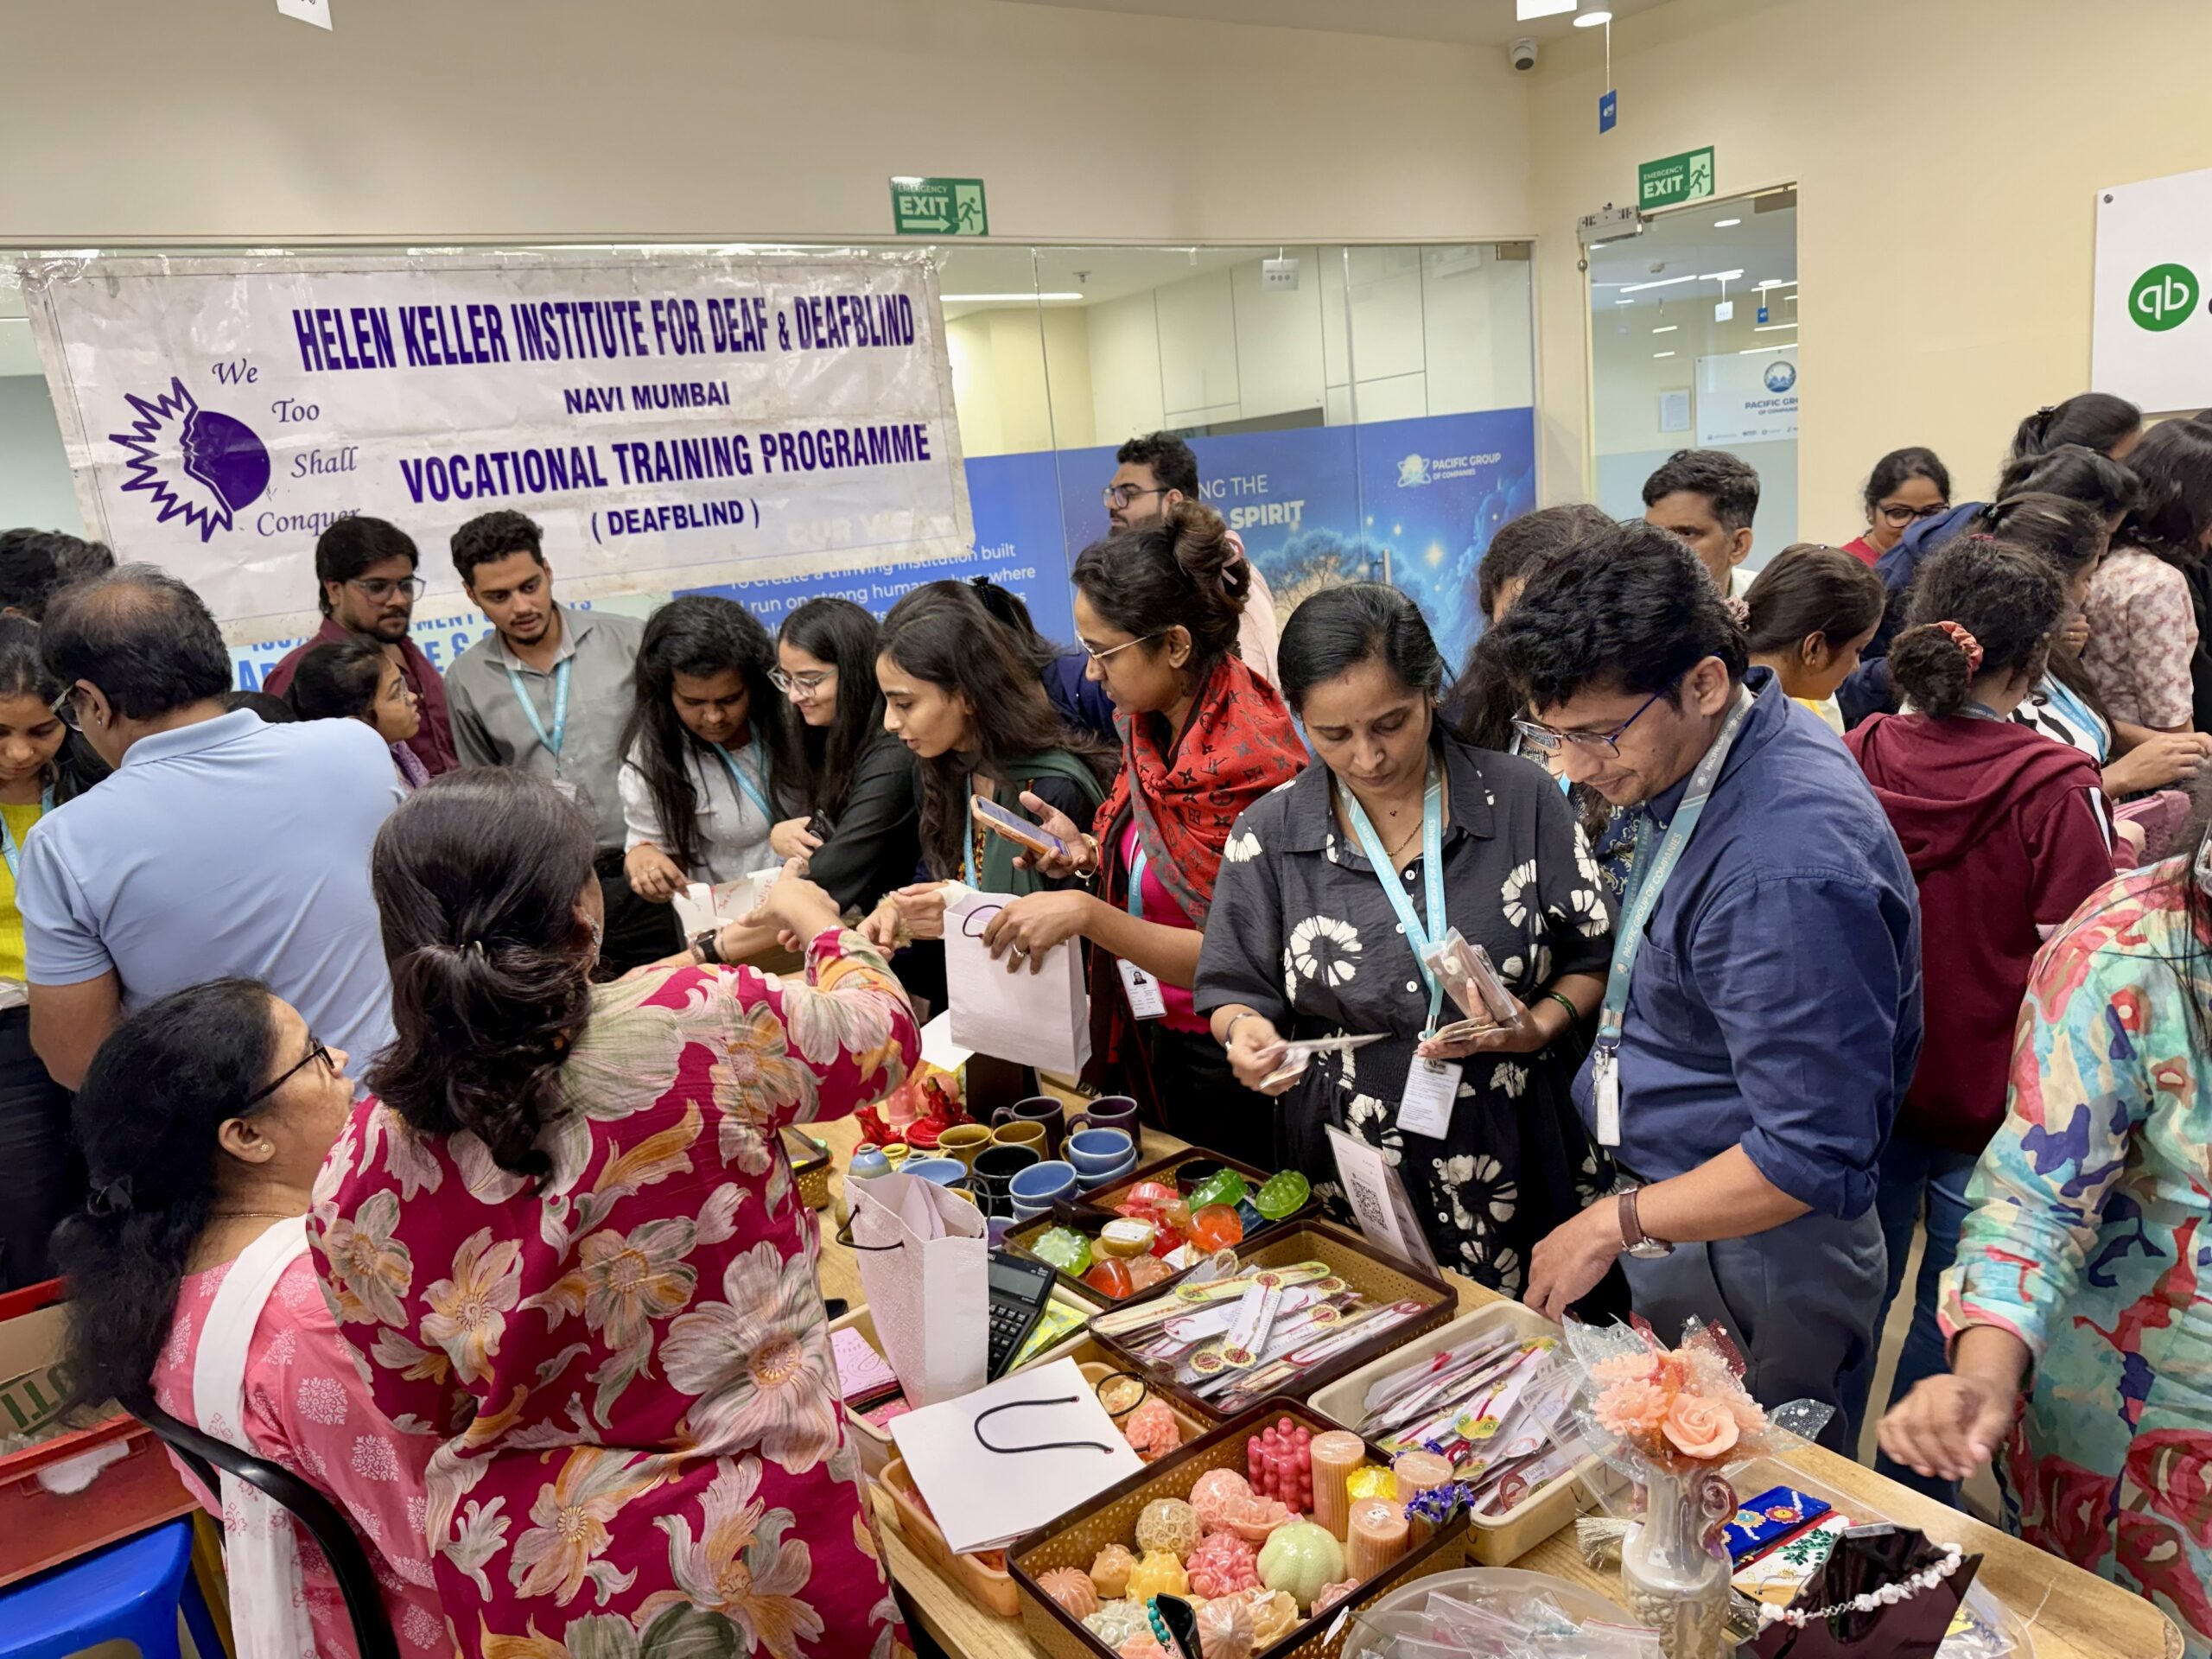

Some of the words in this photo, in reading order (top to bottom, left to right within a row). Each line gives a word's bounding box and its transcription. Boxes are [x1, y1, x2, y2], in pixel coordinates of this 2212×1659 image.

[1643, 165, 1684, 181] EMERGENCY
[1643, 175, 1684, 199] EXIT
[899, 195, 950, 216] EXIT
[293, 308, 396, 371] HELEN
[399, 305, 510, 366] KELLER
[512, 301, 648, 360] INSTITUTE
[651, 299, 704, 355] FOR
[707, 298, 767, 353] DEAF
[778, 312, 791, 348] &
[795, 295, 913, 348] DEAFBLIND
[212, 358, 258, 385] We
[271, 399, 320, 423] Too
[564, 387, 624, 414] NAVI
[632, 382, 729, 410] MUMBAI
[1745, 398, 1780, 410] PACIFIC
[290, 446, 359, 479] Shall
[400, 446, 607, 503] VOCATIONAL
[612, 435, 753, 484] TRAINING
[760, 424, 930, 473] PROGRAMME
[1433, 456, 1468, 470] PACIFIC
[1469, 453, 1502, 466] GROUP
[1441, 468, 1476, 479] COMPANIES
[1230, 474, 1268, 496] THE
[607, 501, 743, 535] DEAFBLIND
[1230, 499, 1305, 530] SPIRIT
[982, 543, 1016, 561] built
[751, 599, 781, 614] run
[785, 595, 808, 608] on
[873, 581, 929, 598] human
[988, 567, 1035, 582] where
[1427, 819, 1436, 865] COMPANIES
[1429, 868, 1437, 880] OF
[1431, 881, 1440, 910] GROUP
[1622, 926, 1638, 959] PACIFIC
[1633, 897, 1649, 928] GROUP
[1645, 881, 1657, 898] OF
[1652, 832, 1682, 885] COMPANIES
